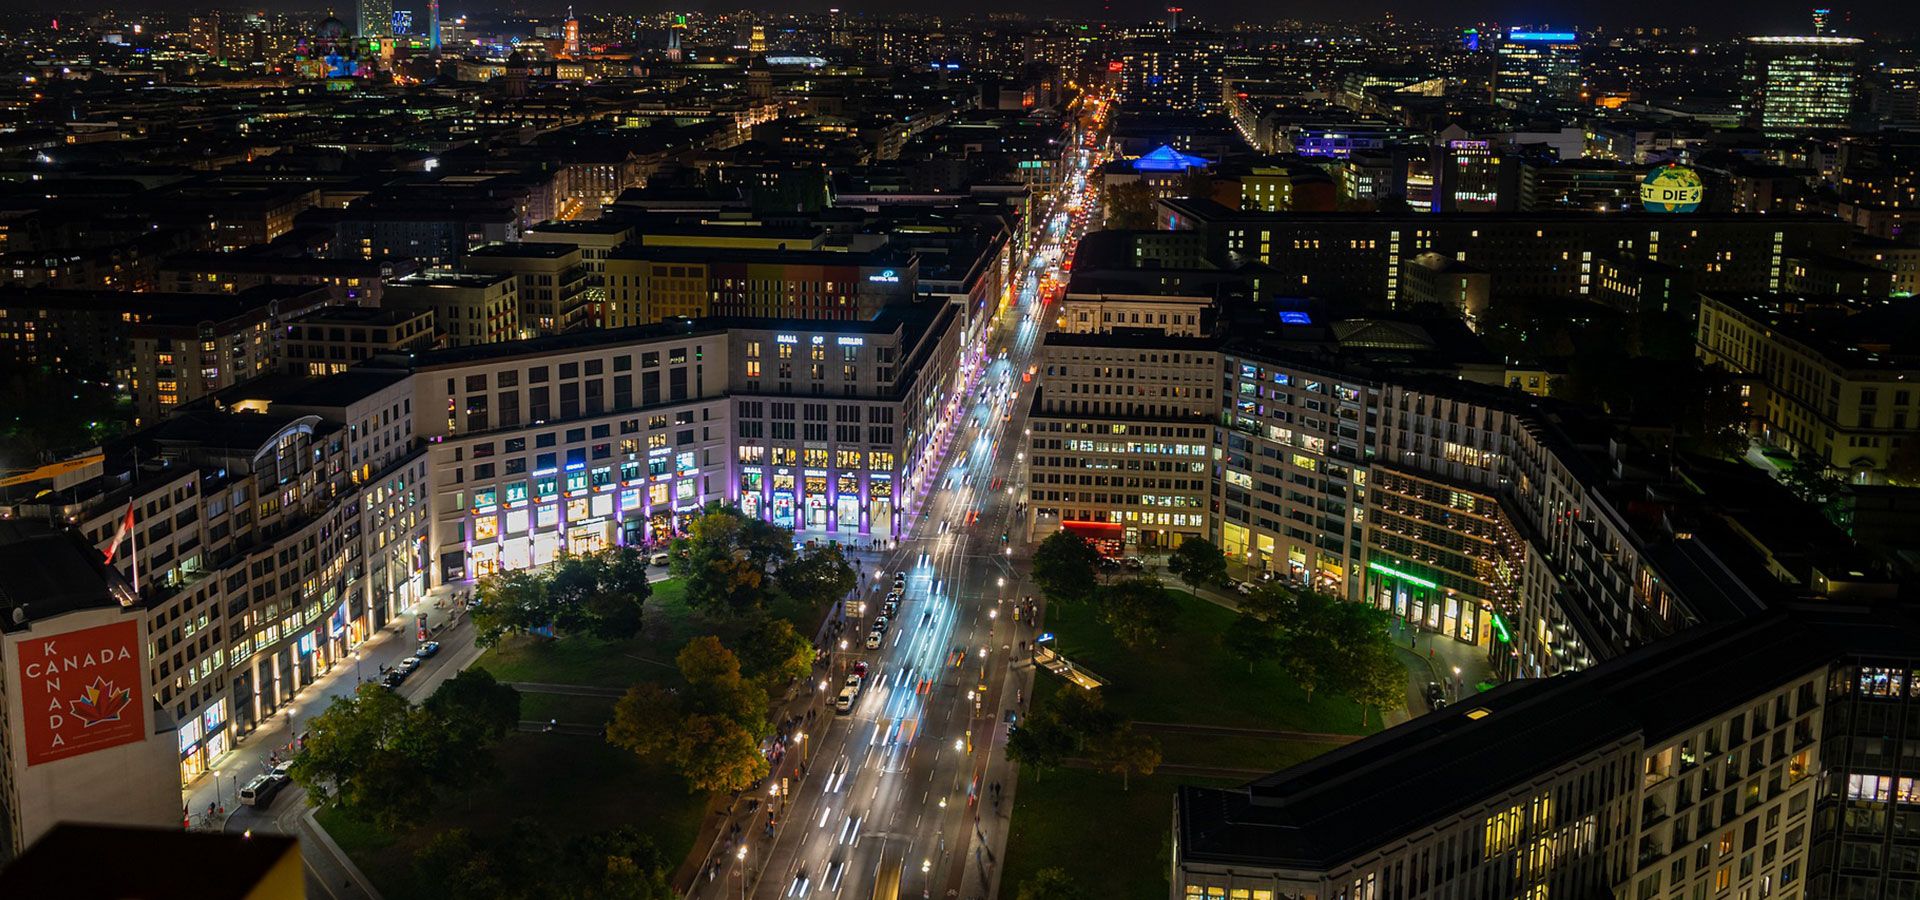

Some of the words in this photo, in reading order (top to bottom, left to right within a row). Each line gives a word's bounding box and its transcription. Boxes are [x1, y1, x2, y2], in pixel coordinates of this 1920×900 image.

[1663, 190, 1687, 200] DIE
[777, 335, 798, 343] MALL
[812, 336, 824, 344] OF
[26, 646, 131, 678] CANADA
[44, 641, 65, 747] KANADA
